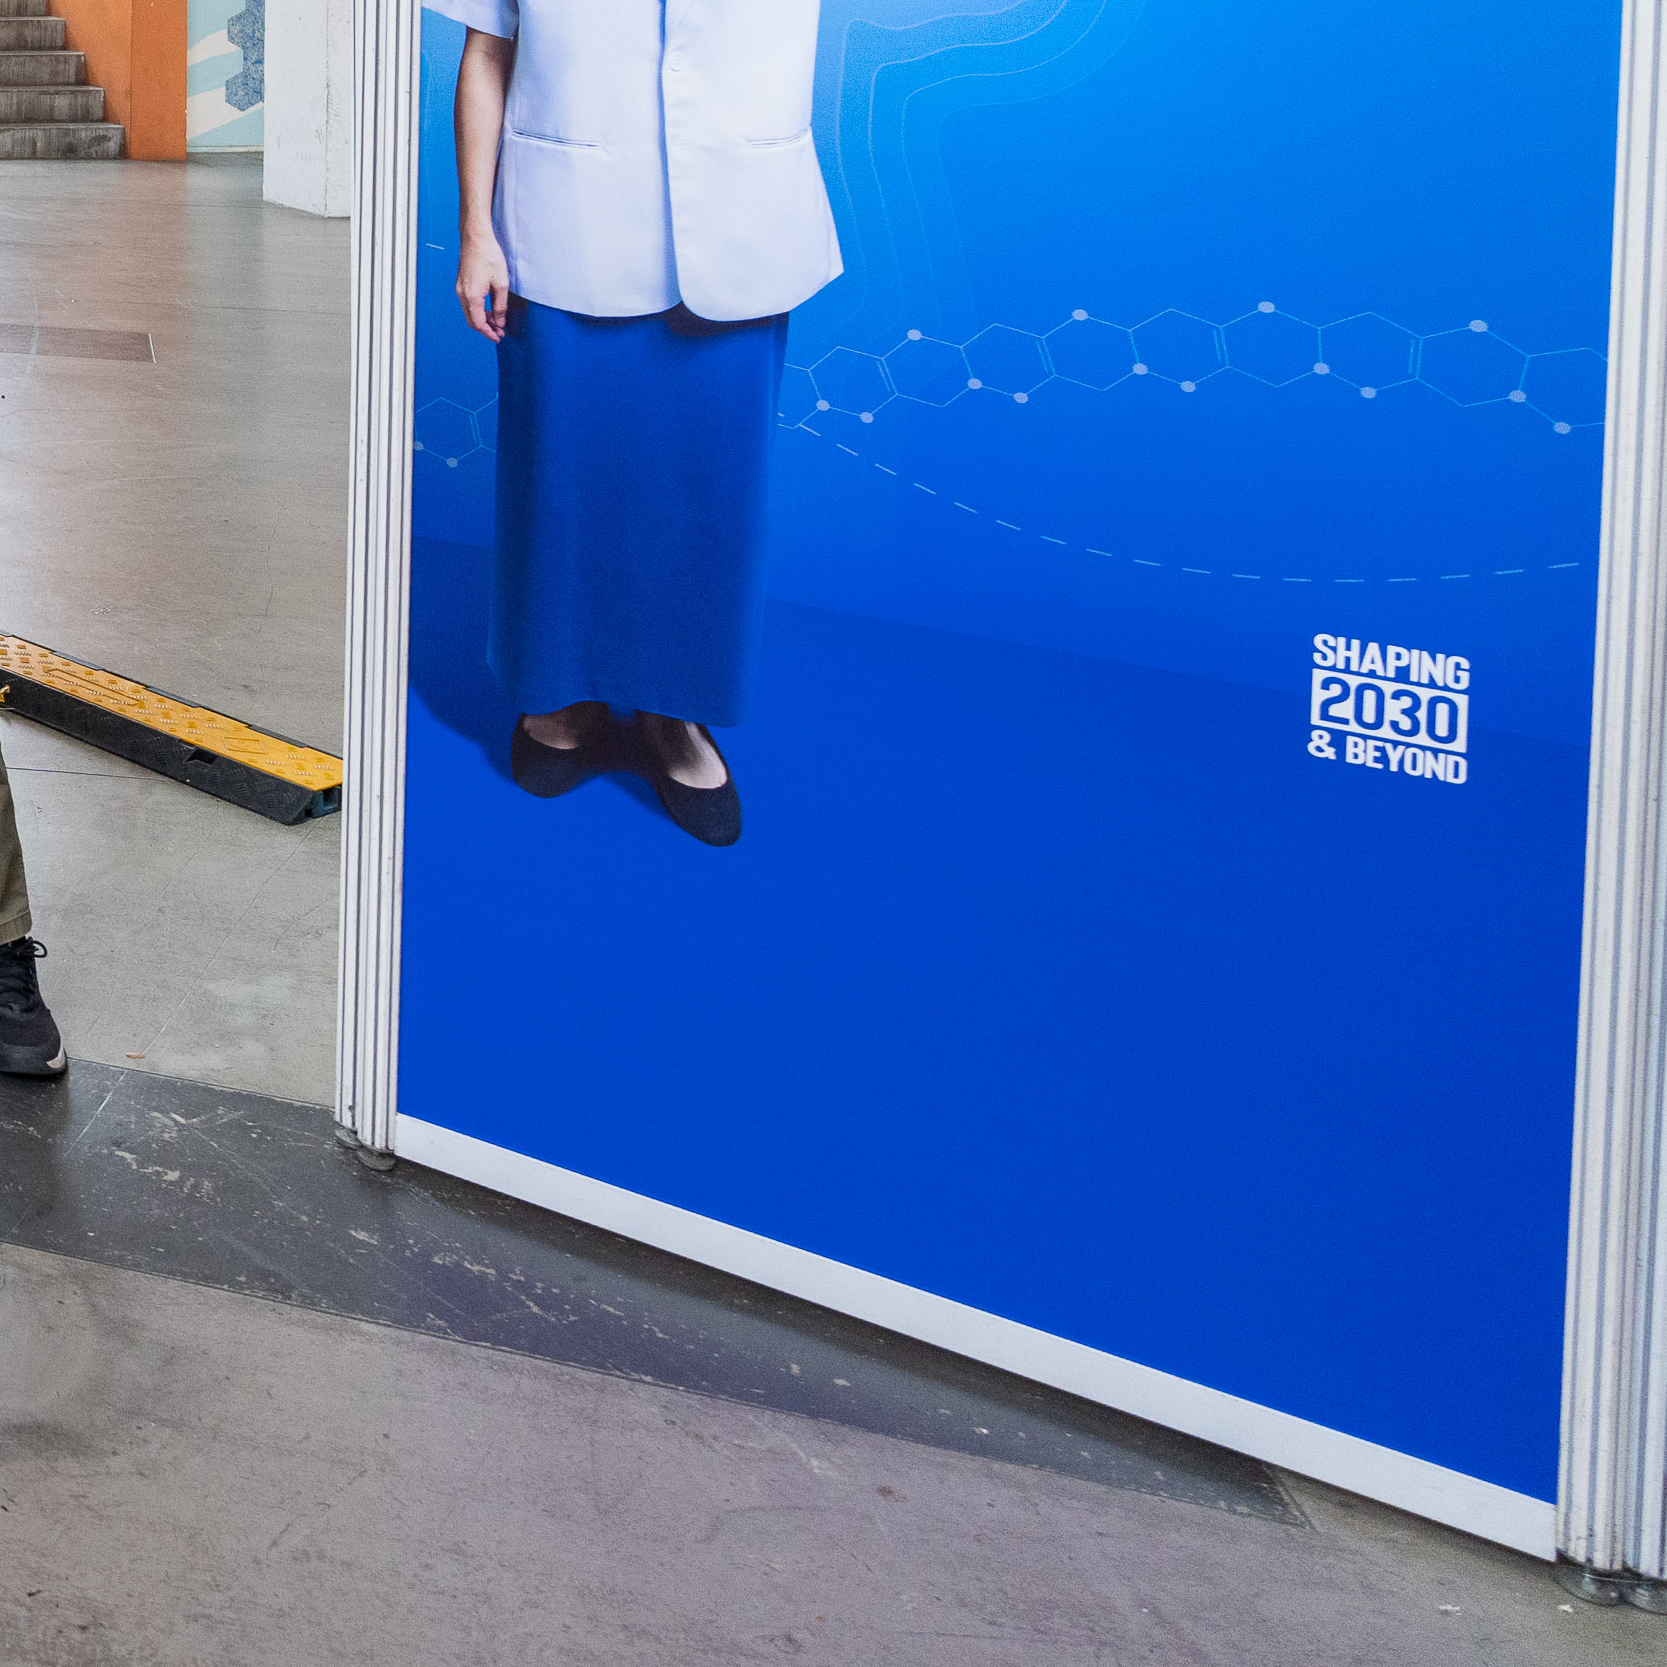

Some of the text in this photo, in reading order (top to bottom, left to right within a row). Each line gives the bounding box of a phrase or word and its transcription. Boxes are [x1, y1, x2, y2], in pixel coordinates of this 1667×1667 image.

[1312, 633, 1470, 690] SHAPING
[1319, 676, 1459, 744] 2030
[1307, 729, 1468, 784] & BEYOND
